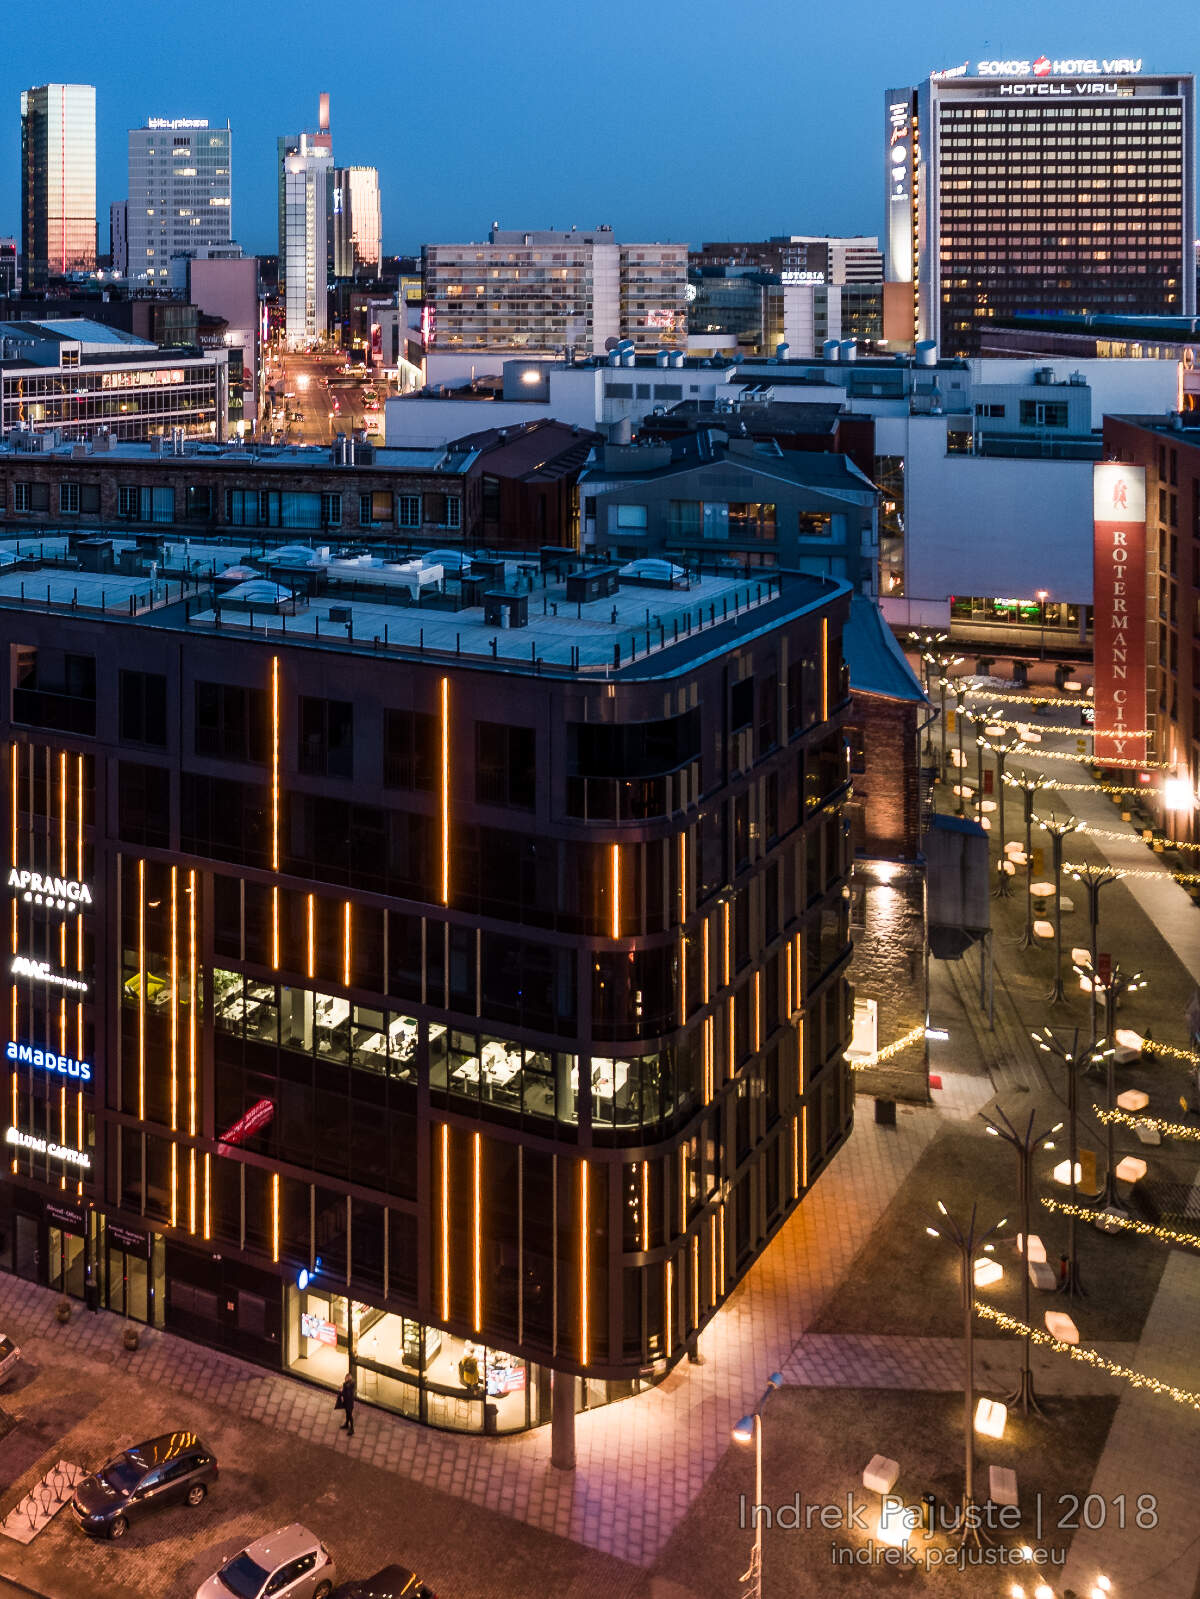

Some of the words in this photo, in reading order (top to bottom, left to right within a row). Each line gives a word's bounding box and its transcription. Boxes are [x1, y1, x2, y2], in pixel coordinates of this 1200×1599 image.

[977, 60, 1030, 75] SOKOS
[1053, 59, 1101, 74] HOTEL
[1102, 58, 1142, 74] VIRU
[1000, 83, 1071, 95] HOTELL
[1076, 83, 1118, 94] VIRU
[781, 271, 825, 280] ESTORIA
[1112, 531, 1129, 679] ROTERMANN
[1113, 689, 1128, 754] CITY
[8, 868, 93, 904] APRANGA
[19, 1131, 47, 1153] LUMI
[47, 1143, 91, 1168] CAPITAL
